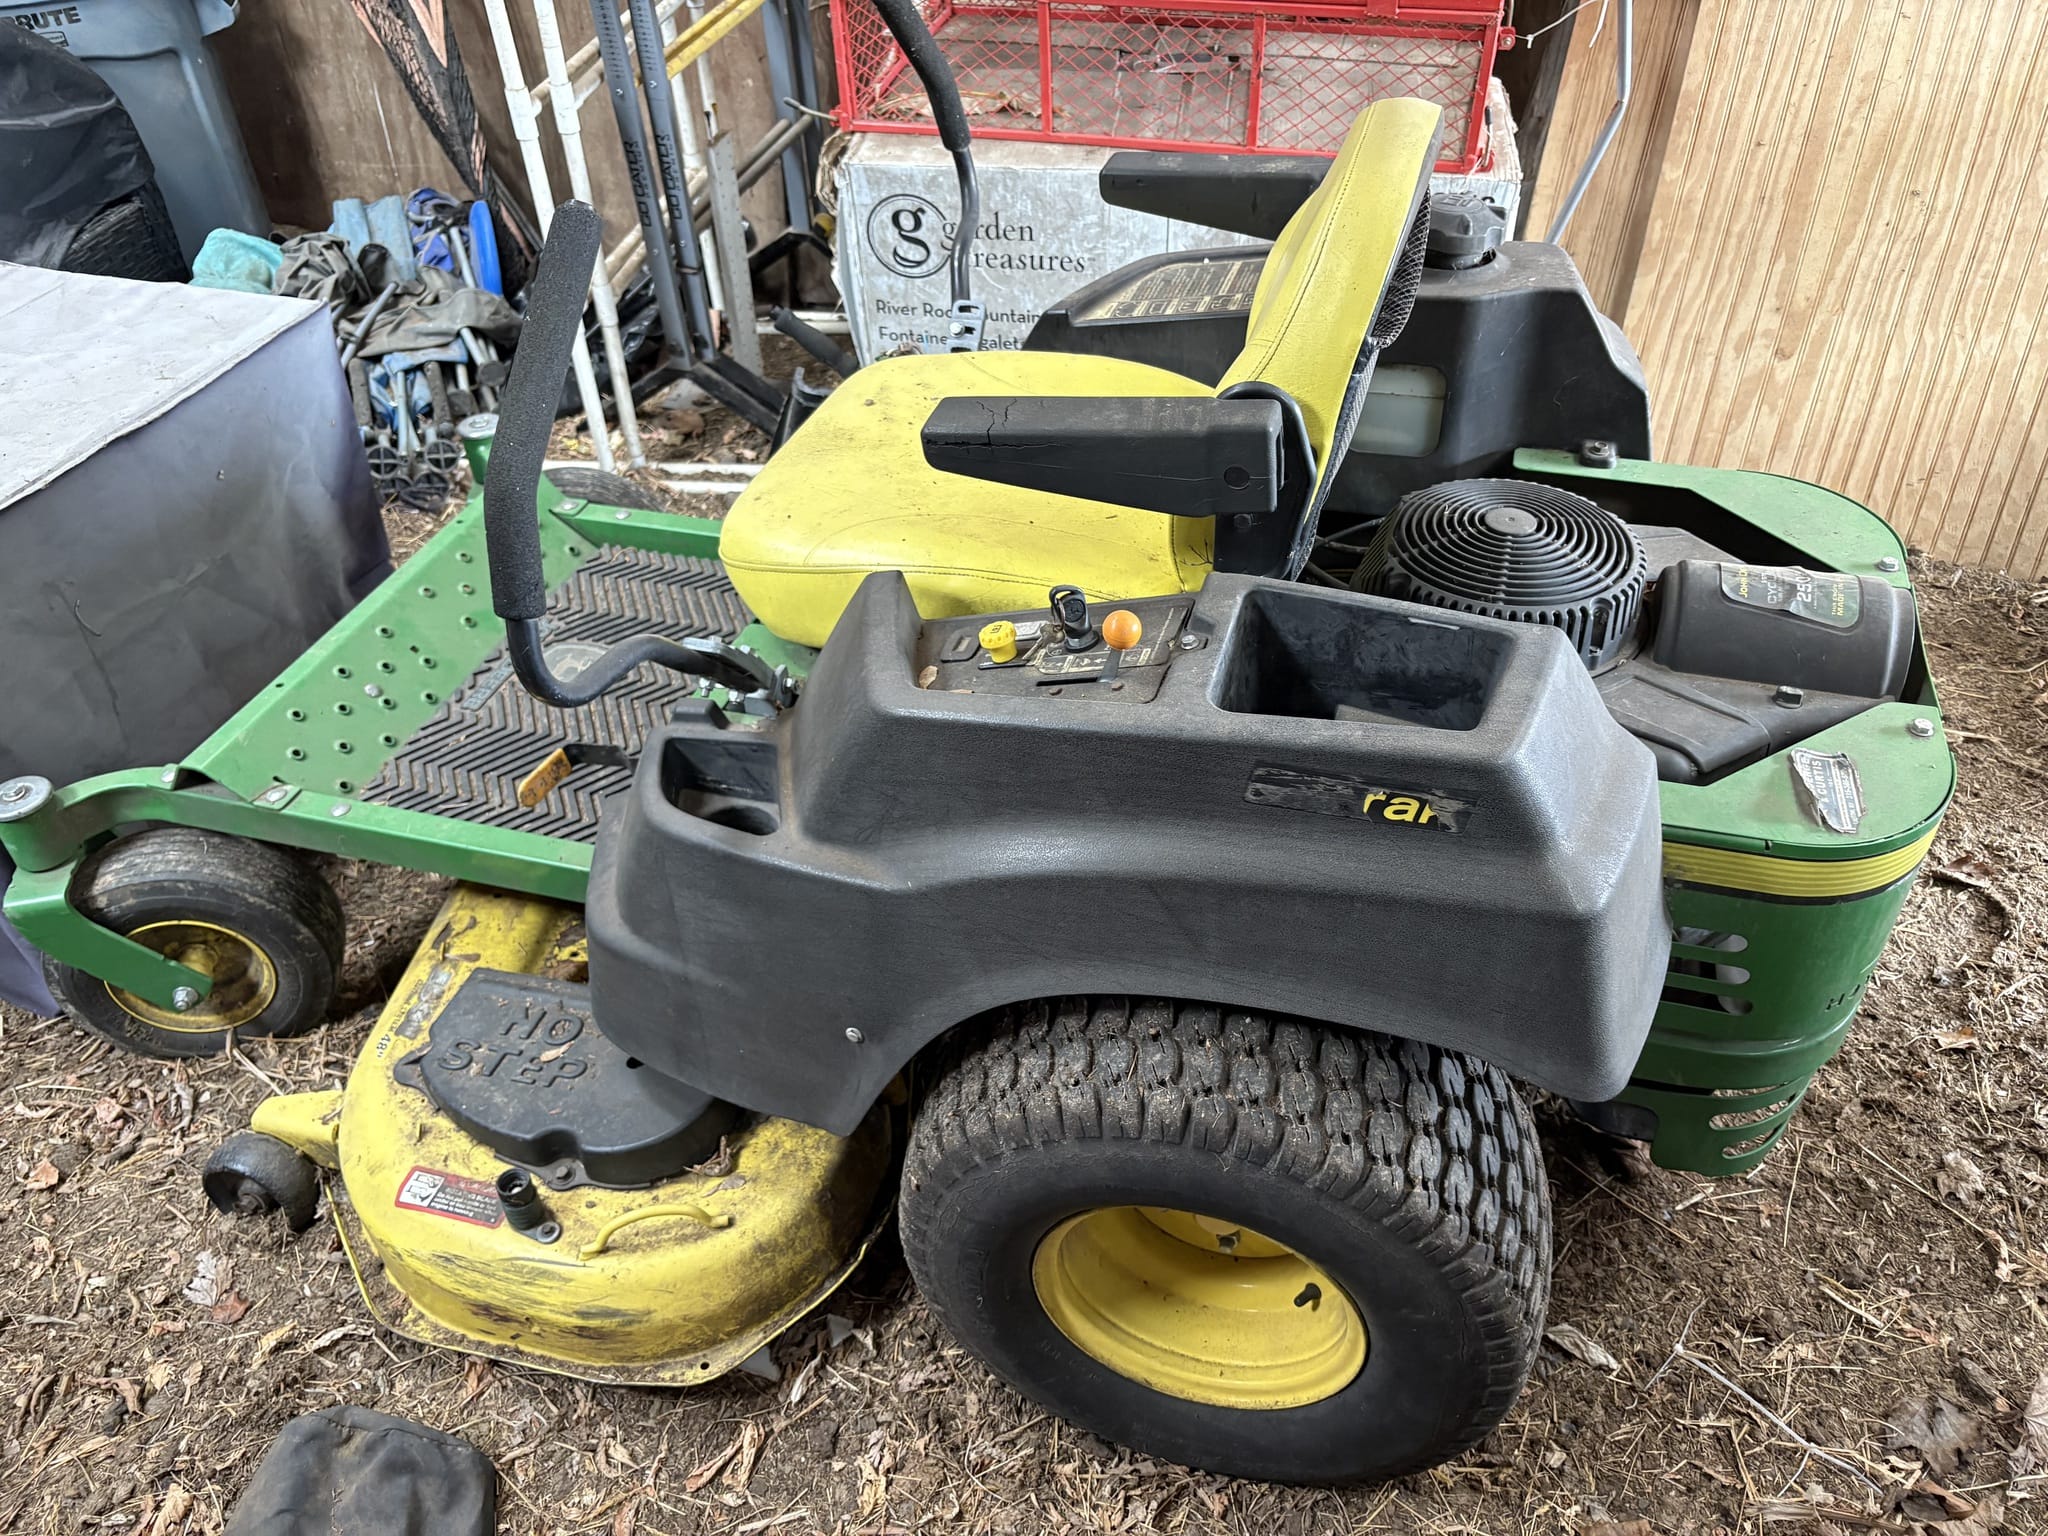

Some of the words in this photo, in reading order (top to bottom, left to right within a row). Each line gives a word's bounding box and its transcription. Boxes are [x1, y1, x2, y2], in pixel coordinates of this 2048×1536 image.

[15, 6, 82, 30] RUTE
[940, 211, 1035, 251] grden
[973, 249, 1085, 273] reasures
[875, 299, 918, 316] River
[922, 302, 953, 319] Roc
[988, 309, 1040, 324] untain
[878, 326, 948, 345] Fontaine
[980, 334, 1027, 351] galet
[1811, 760, 1828, 798] CURTIS
[500, 1006, 585, 1046] NO
[438, 1038, 588, 1088] STEP
